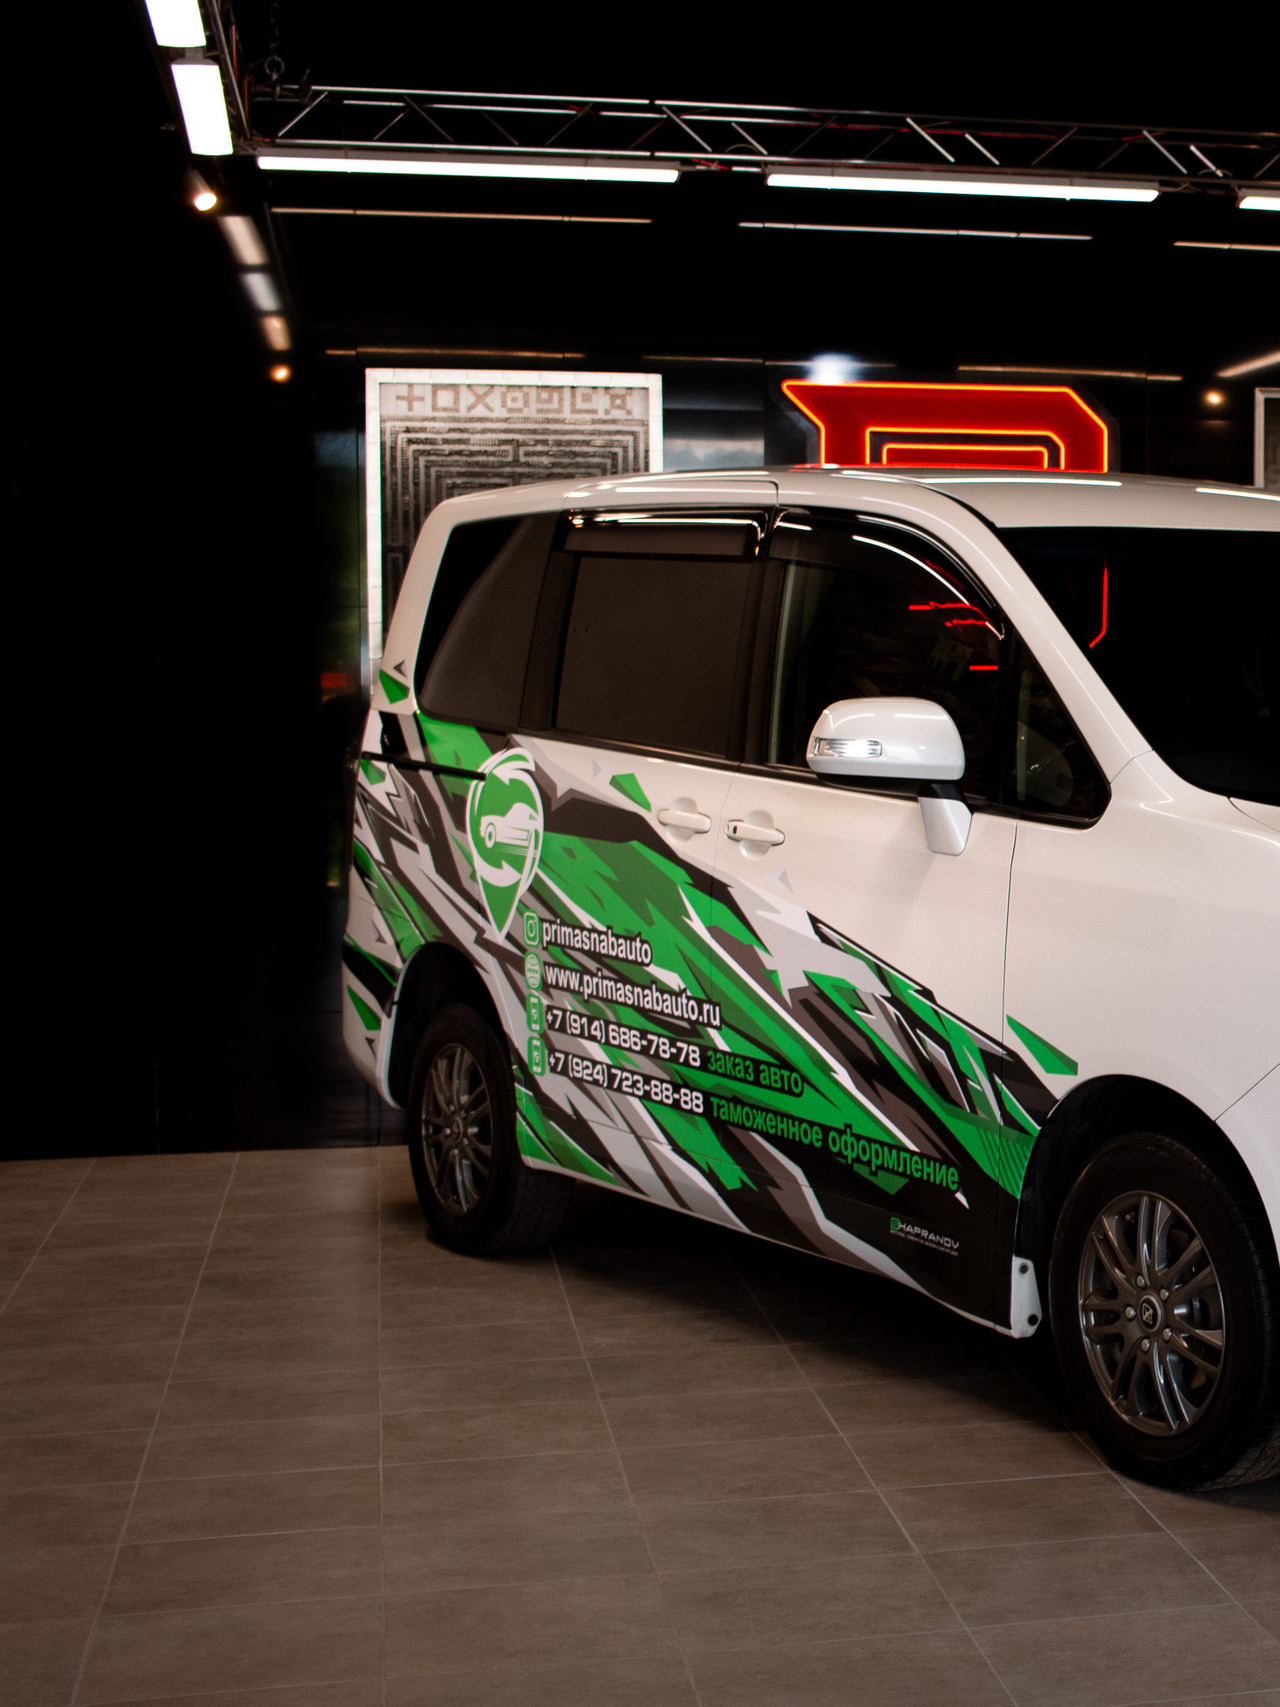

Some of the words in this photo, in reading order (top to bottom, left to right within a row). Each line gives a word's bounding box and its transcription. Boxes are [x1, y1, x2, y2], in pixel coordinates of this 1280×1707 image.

[542, 918, 652, 964] primasnabauto
[545, 965, 721, 1027] www.primasnabauto.ru
[546, 1010, 563, 1029] +7
[566, 1011, 605, 1043] (914)
[609, 1024, 701, 1067] 686-78-78
[707, 1051, 754, 1081] заказ
[760, 1065, 802, 1094] авто
[549, 1053, 565, 1072] +7
[568, 1054, 608, 1087] (924)
[611, 1068, 704, 1114] 723-88-88
[710, 1096, 823, 1148] таможенное
[828, 1128, 959, 1191] оформление
[890, 1216, 960, 1249] SHAPRANOV
